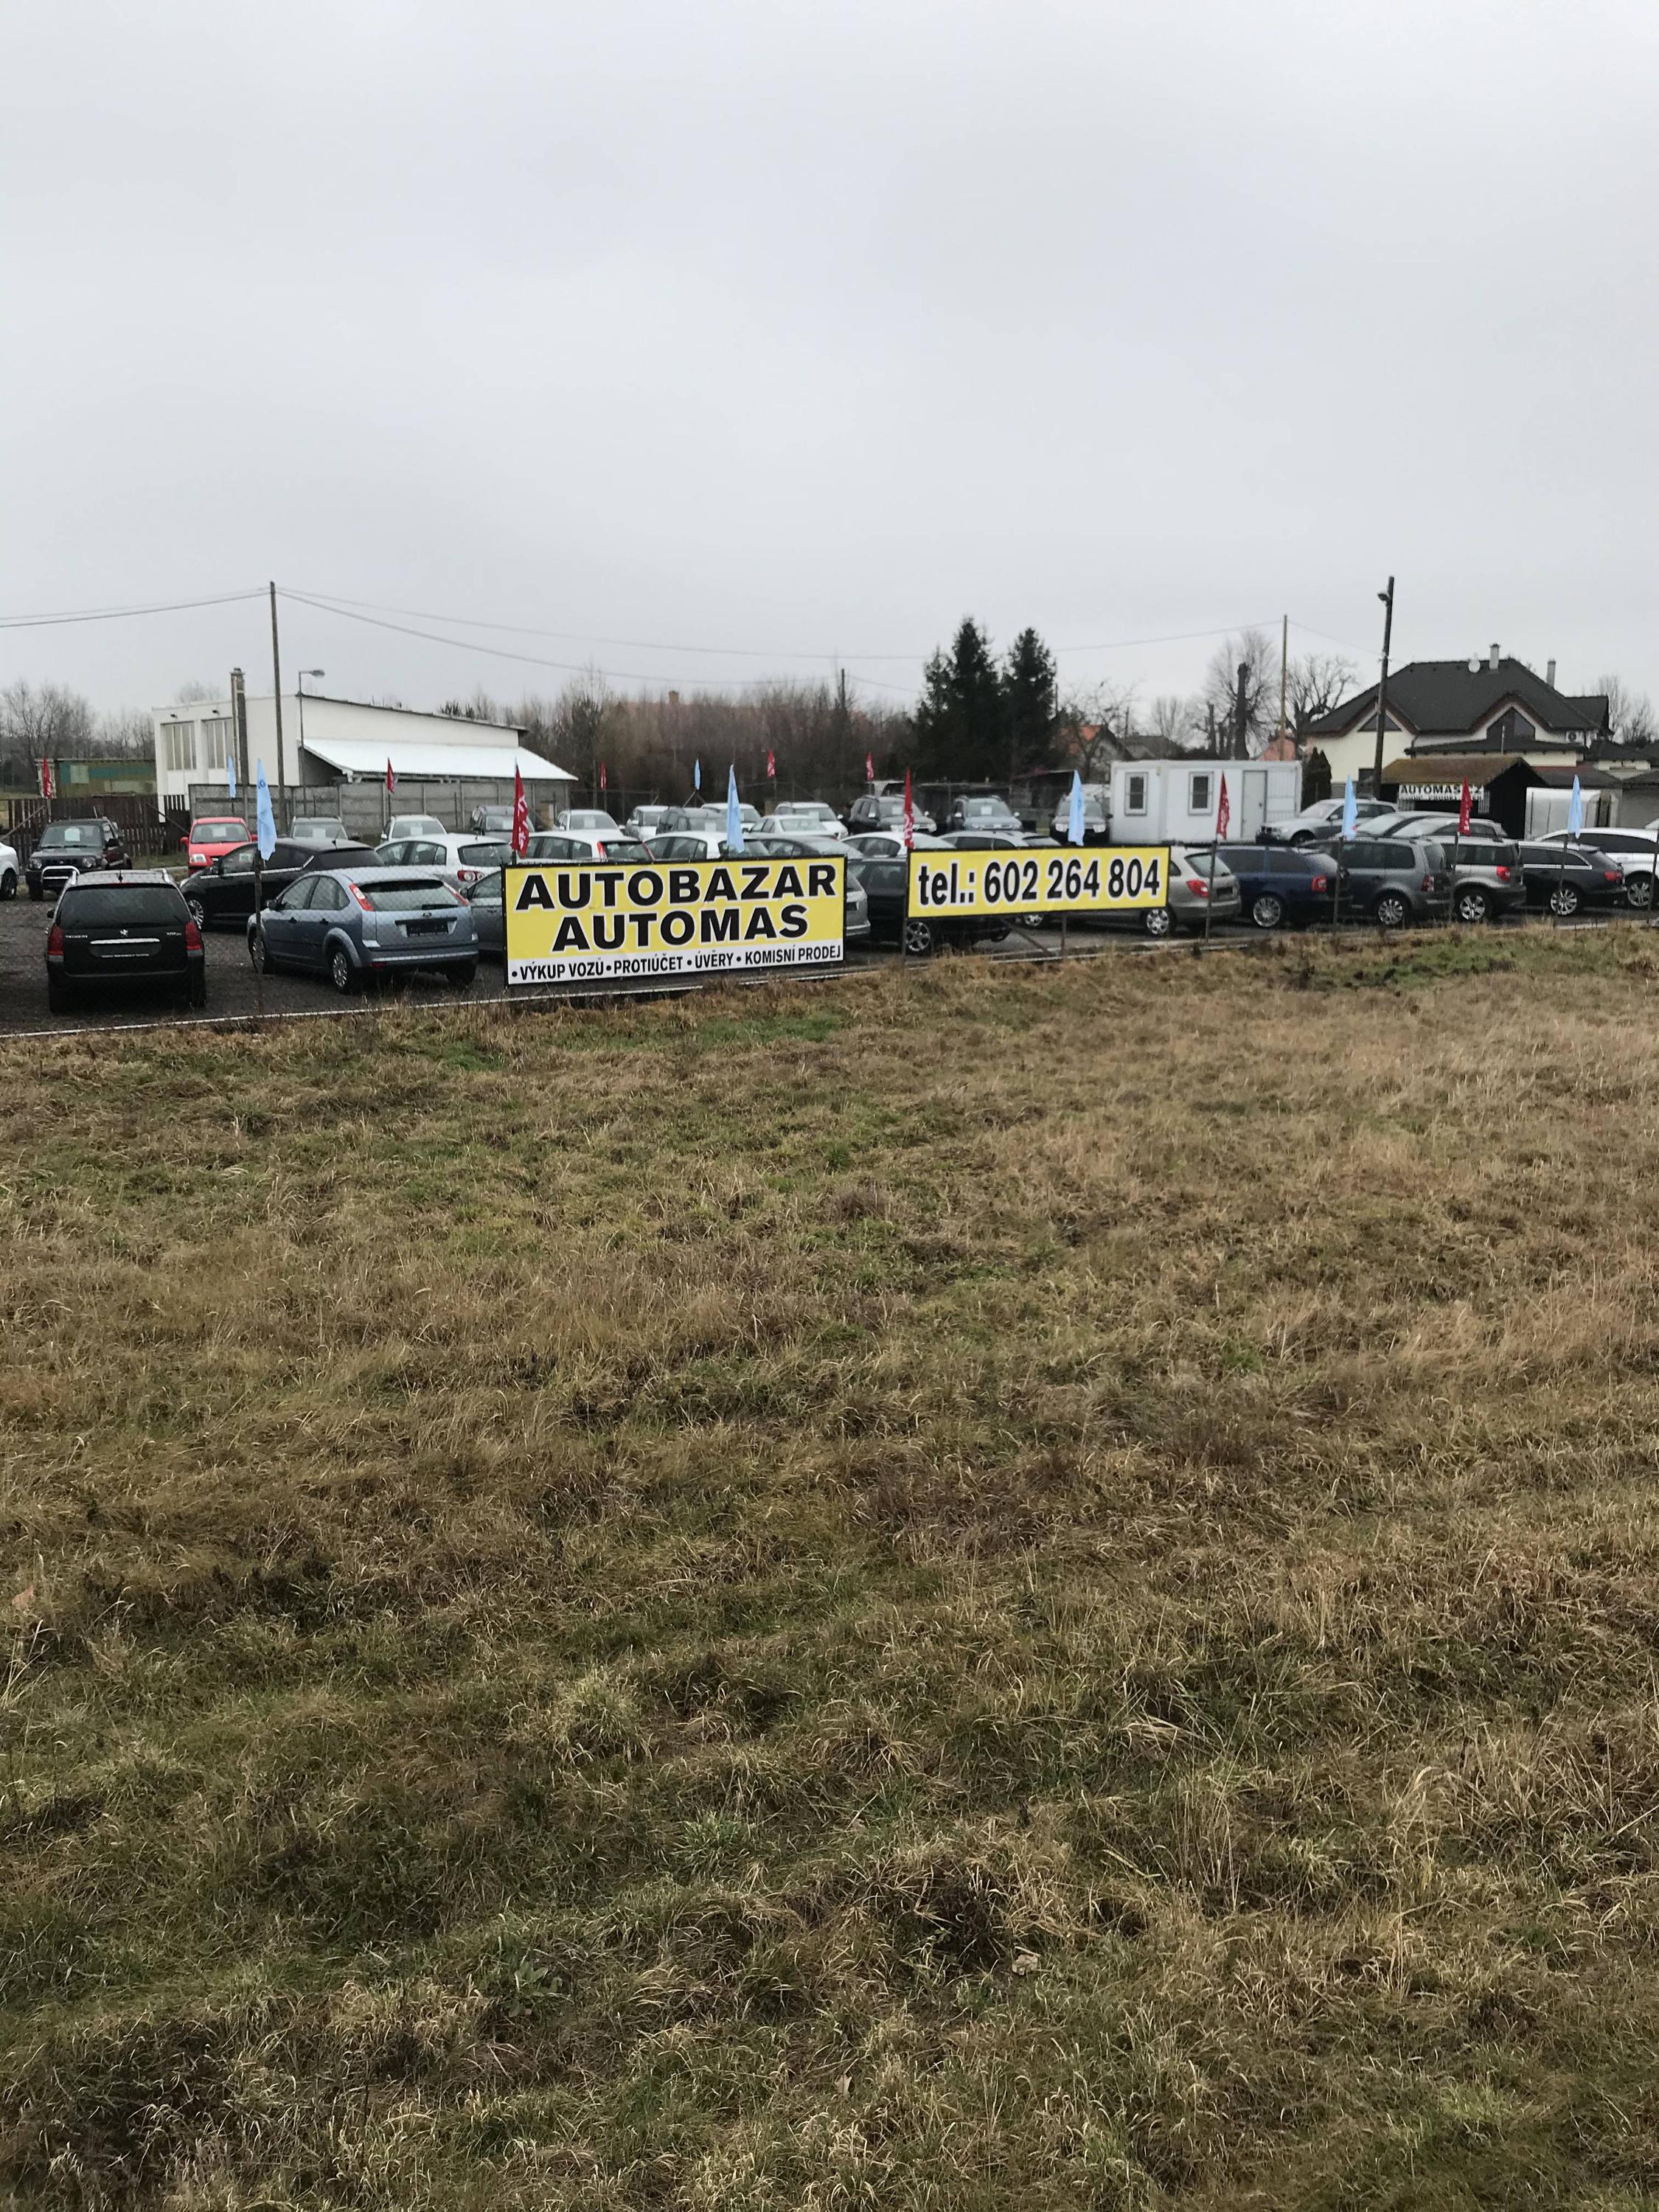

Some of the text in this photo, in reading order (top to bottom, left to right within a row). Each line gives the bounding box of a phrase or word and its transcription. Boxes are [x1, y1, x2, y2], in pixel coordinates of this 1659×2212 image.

[515, 864, 836, 911] AUTOBAZAR
[918, 858, 1160, 905] tel.: 602 264 804
[552, 904, 808, 952] AUTOMAS
[520, 961, 566, 981] VÝKUP
[695, 950, 734, 969] ÚVĚRY
[745, 945, 796, 965] KOMISNÍ
[798, 945, 841, 961] PRODEJ
